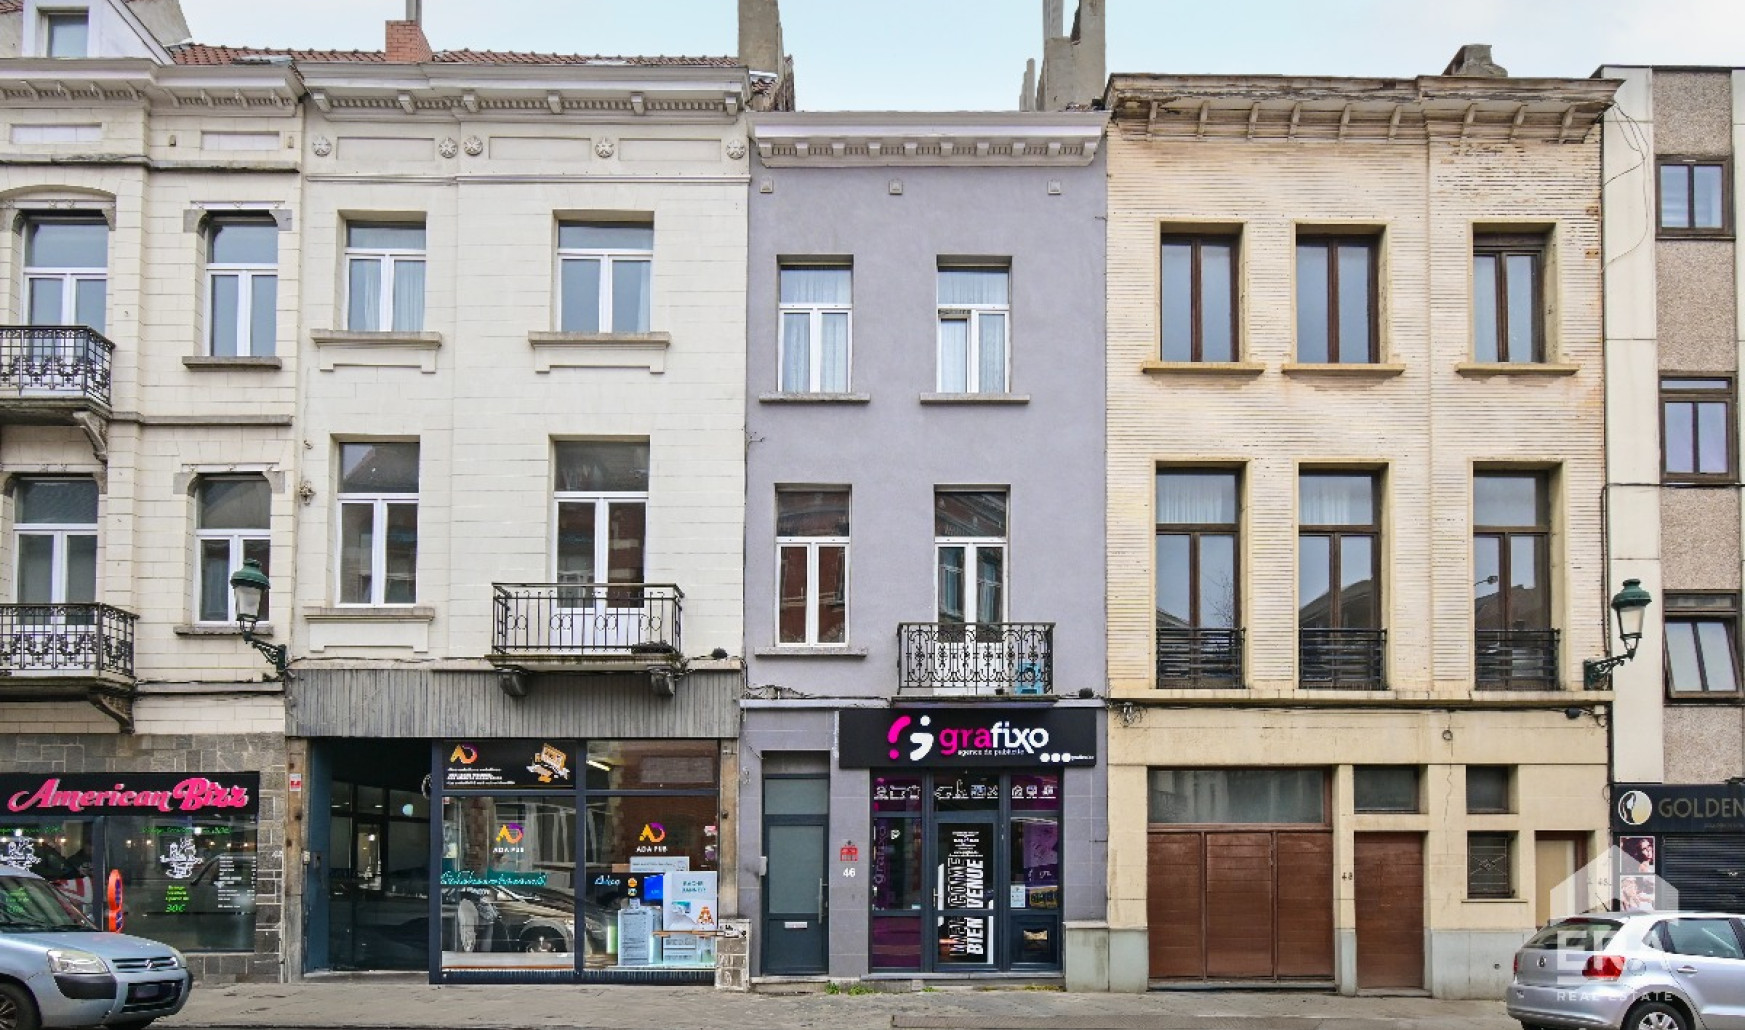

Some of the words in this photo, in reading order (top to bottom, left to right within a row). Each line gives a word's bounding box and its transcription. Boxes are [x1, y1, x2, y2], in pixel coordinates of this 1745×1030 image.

[939, 721, 1049, 754] grafixo
[8, 778, 173, 812] American
[172, 777, 249, 811] Bizz
[1658, 797, 1745, 817] GOLDEN
[843, 867, 856, 878] 46
